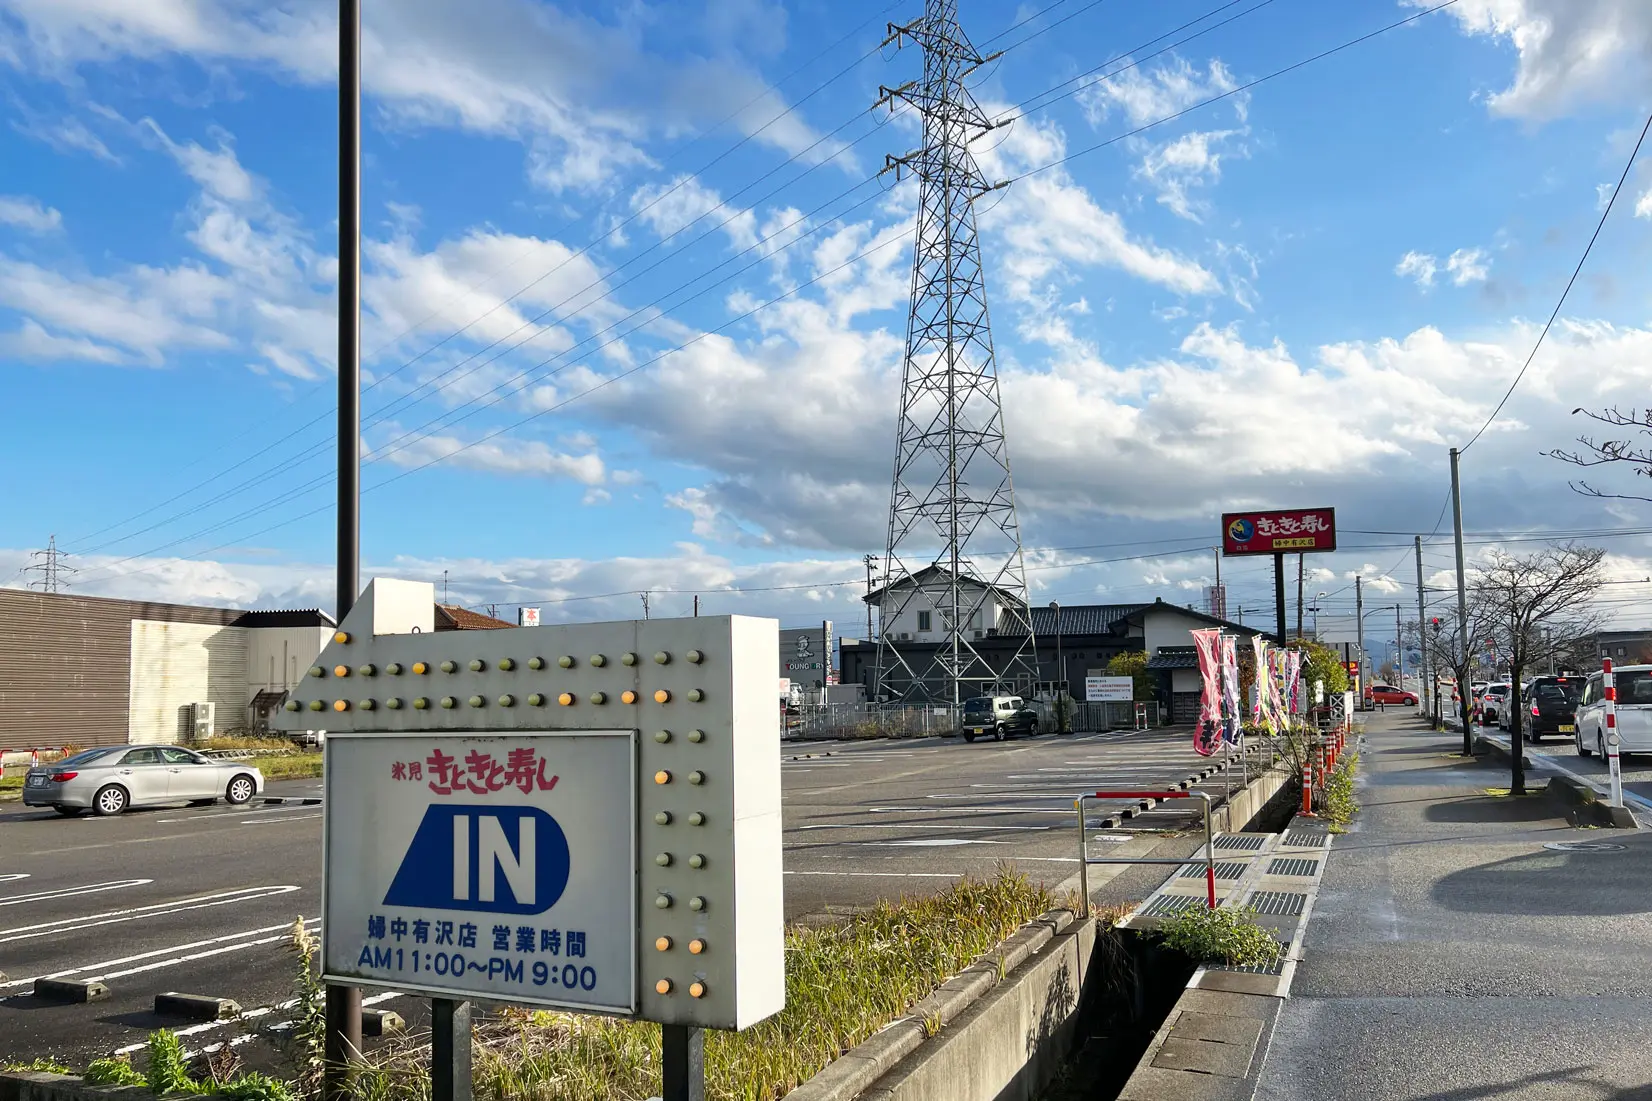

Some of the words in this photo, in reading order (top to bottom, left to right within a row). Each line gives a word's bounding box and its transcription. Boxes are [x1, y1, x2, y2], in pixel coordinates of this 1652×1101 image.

[1257, 515, 1329, 536] きときと寿し
[392, 761, 423, 781] 氷見
[427, 748, 559, 795] きときと寿し
[453, 814, 536, 905] IN
[368, 915, 477, 949] 婦中有沢店
[492, 925, 586, 958] 営業時間
